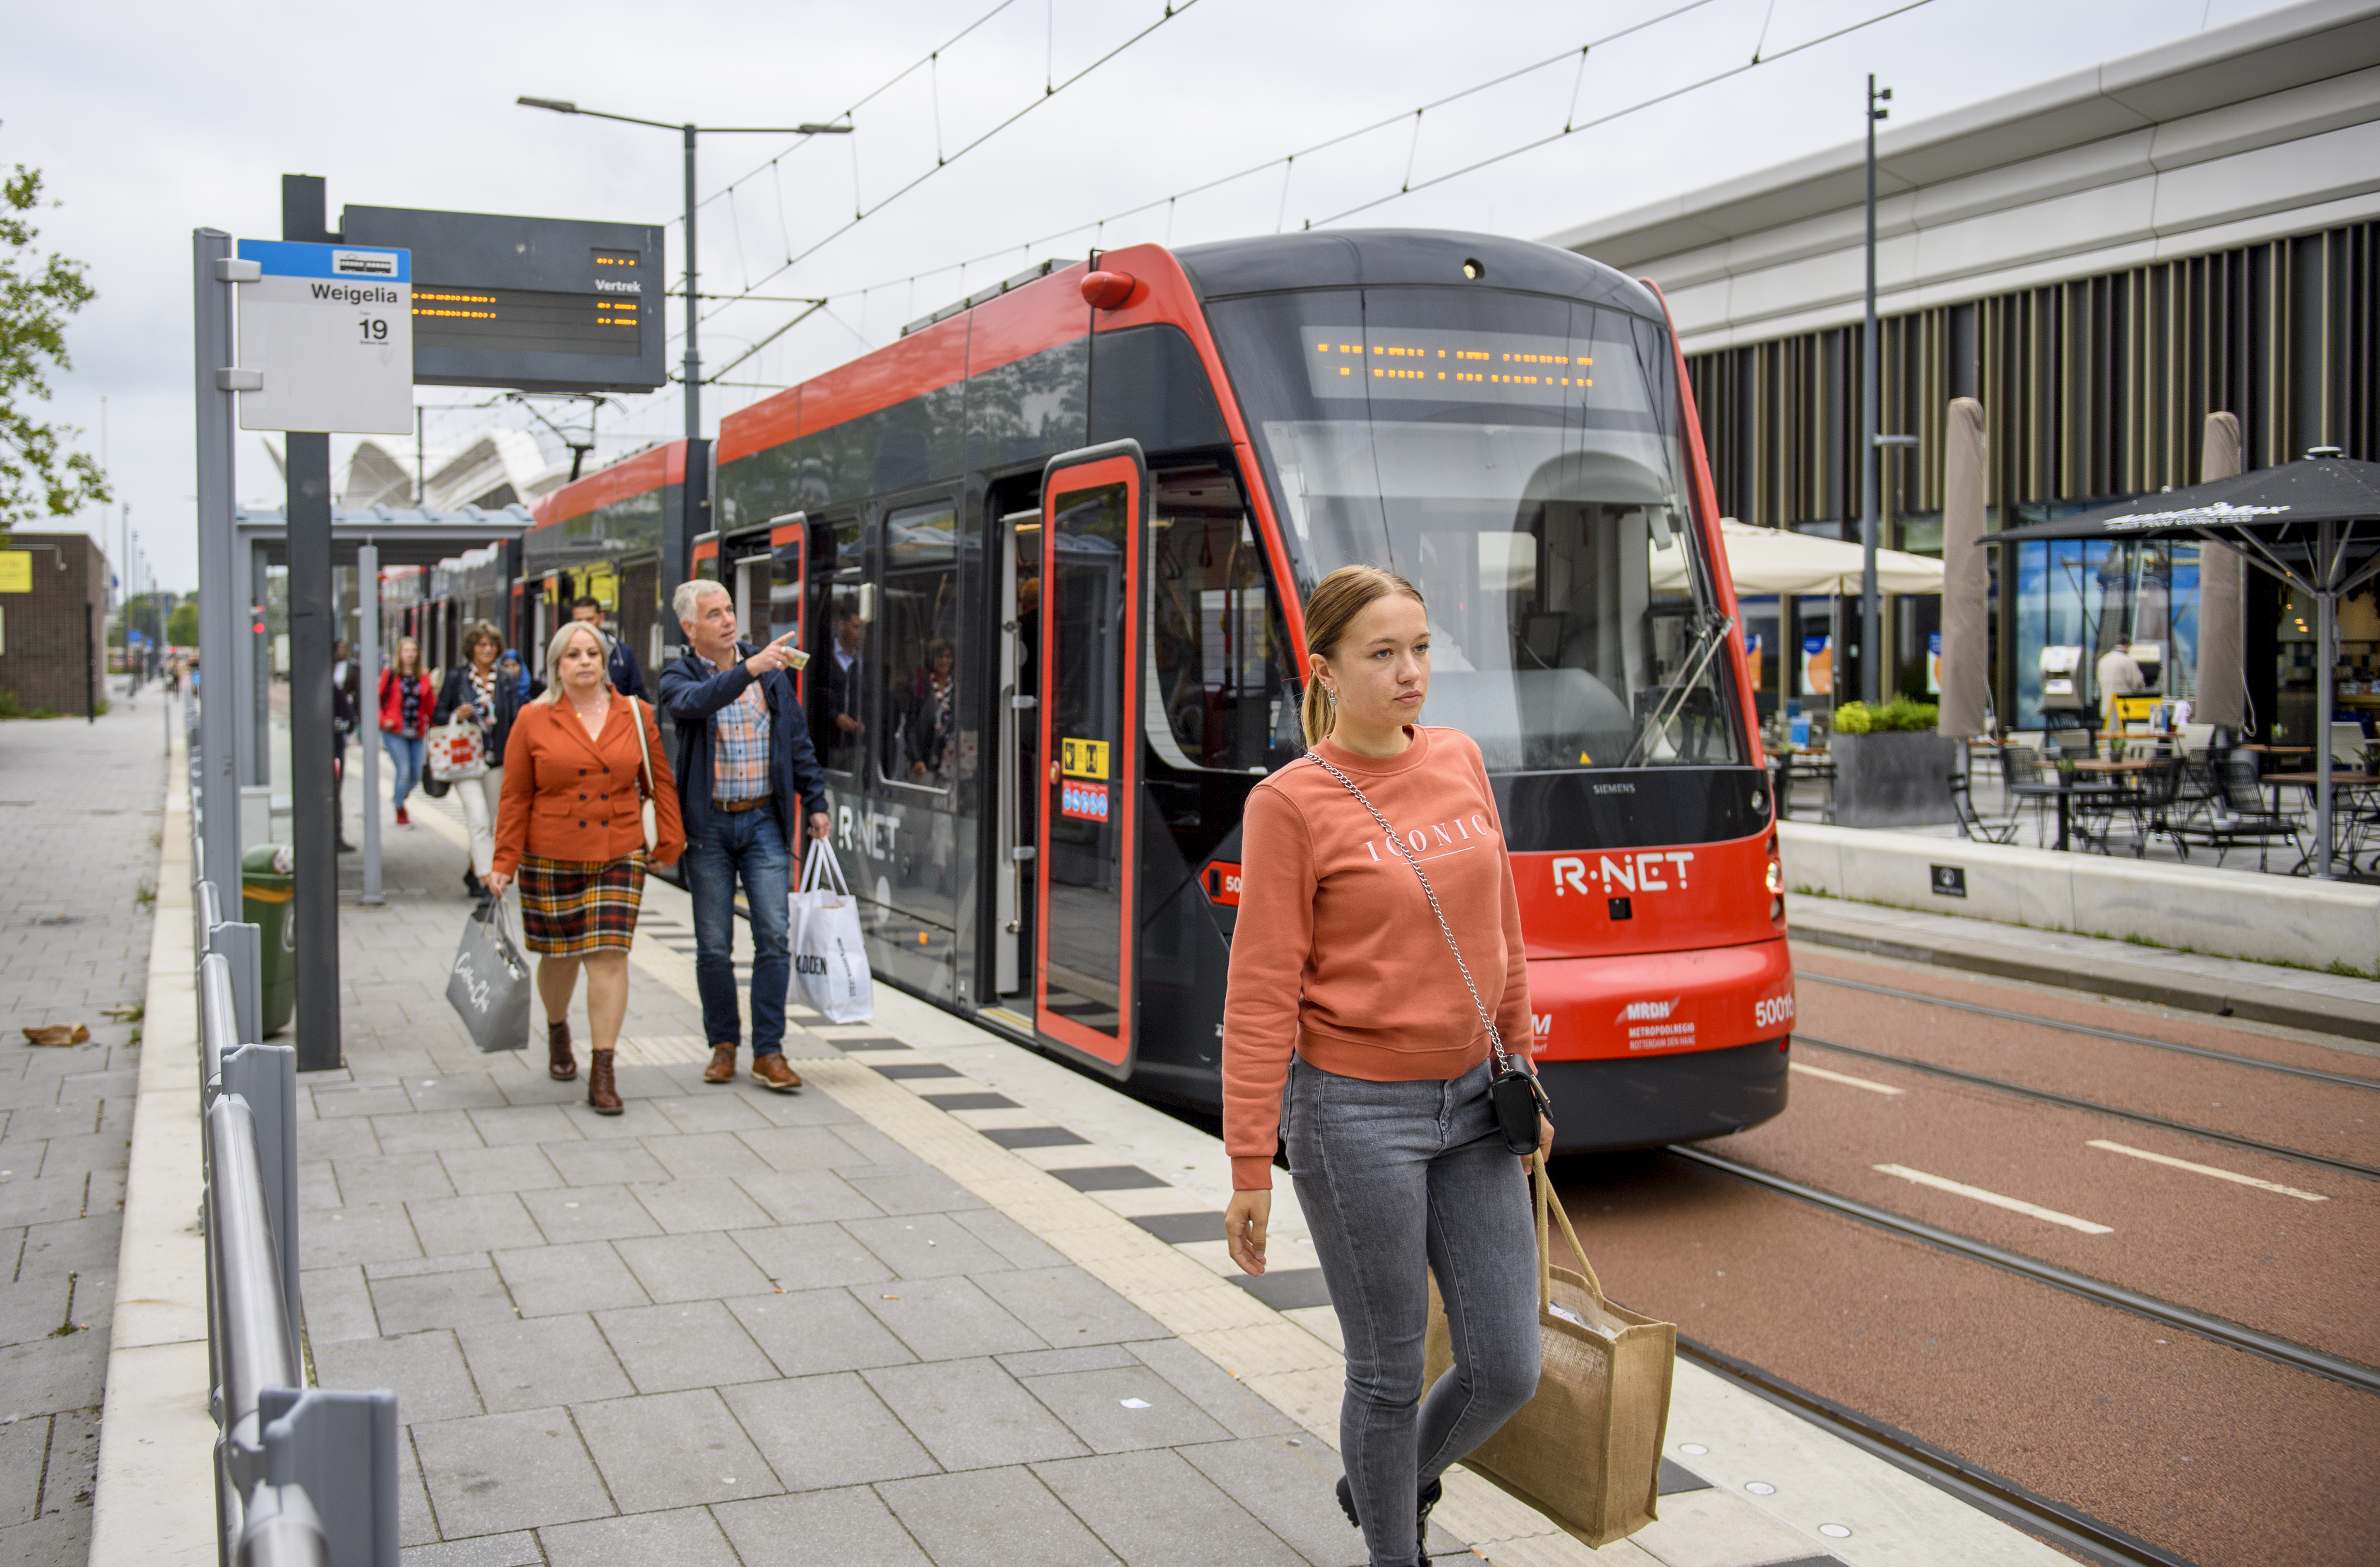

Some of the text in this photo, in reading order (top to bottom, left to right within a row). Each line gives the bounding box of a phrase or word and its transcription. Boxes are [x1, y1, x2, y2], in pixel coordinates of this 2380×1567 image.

[311, 283, 397, 304] Weigelia
[595, 279, 641, 292] Vertrek
[359, 318, 388, 339] 19
[1593, 783, 1635, 795] SIEMENS
[1364, 815, 1486, 861] ICONIC
[1627, 1001, 1669, 1021] MRDH
[1629, 1022, 1695, 1039] METROPOOLREGIO
[1629, 1035, 1695, 1051] ROTTERDAM DEN HAAG
